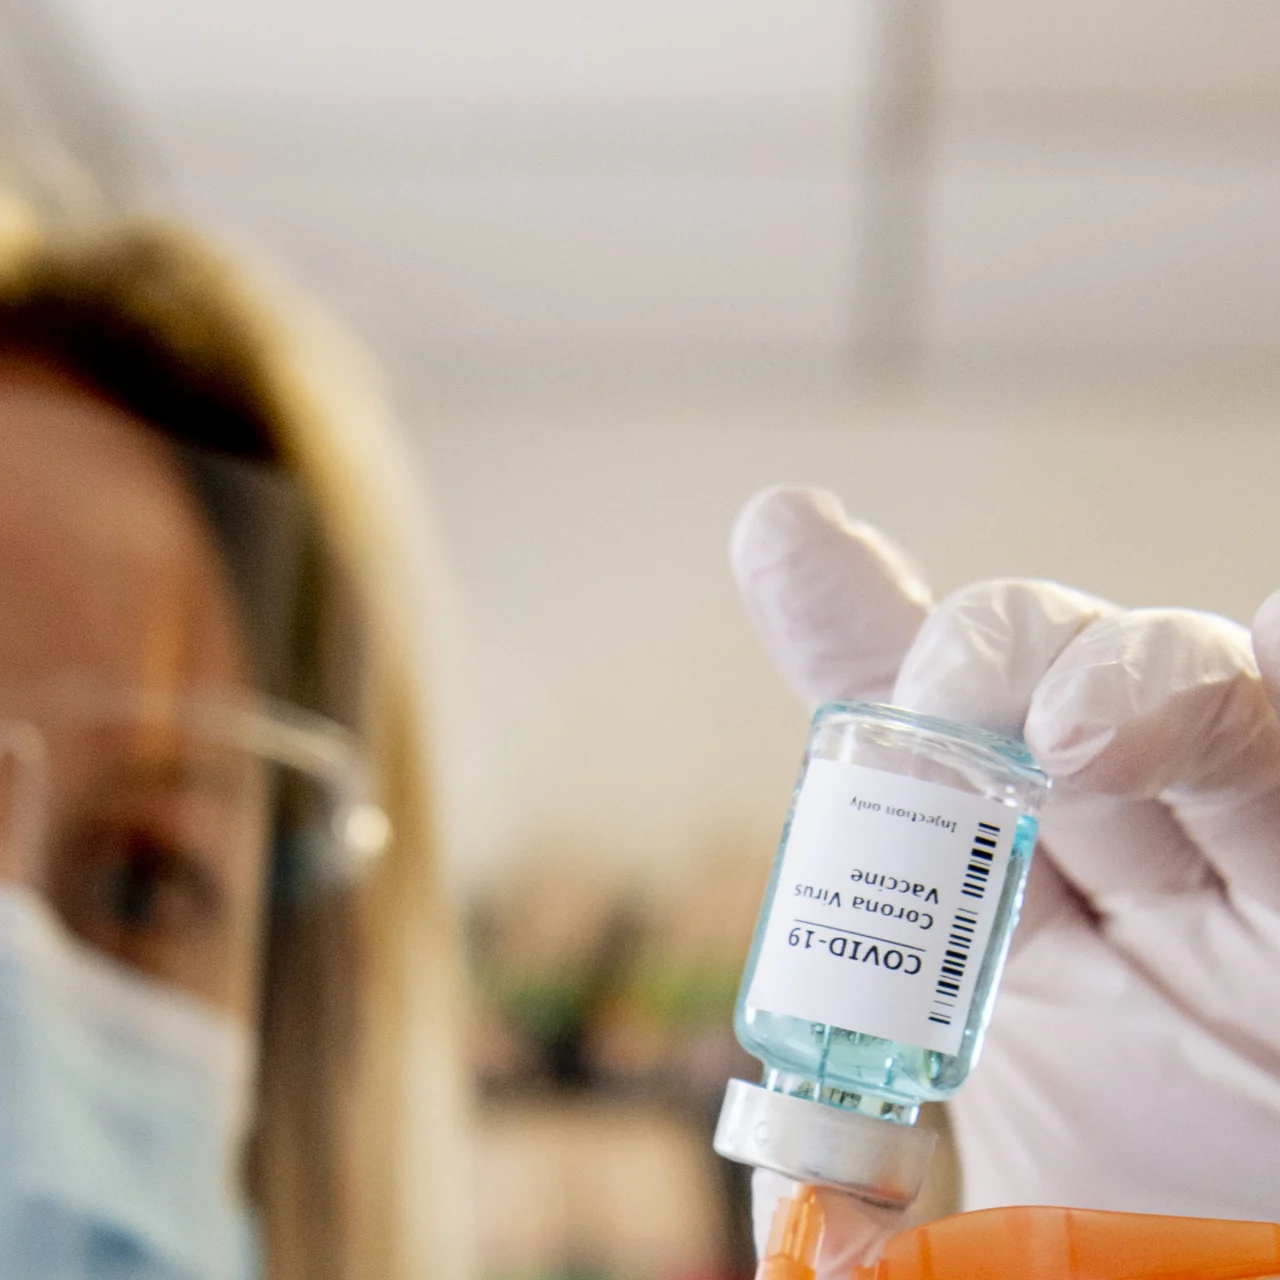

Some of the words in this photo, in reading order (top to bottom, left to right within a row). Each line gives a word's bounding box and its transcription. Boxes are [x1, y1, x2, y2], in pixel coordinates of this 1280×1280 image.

[849, 796, 882, 813] only
[886, 806, 958, 833] Injection
[794, 883, 841, 908] Virus
[850, 868, 939, 905] Vaccine
[852, 896, 934, 930] Corona
[788, 927, 922, 975] COVID-19
